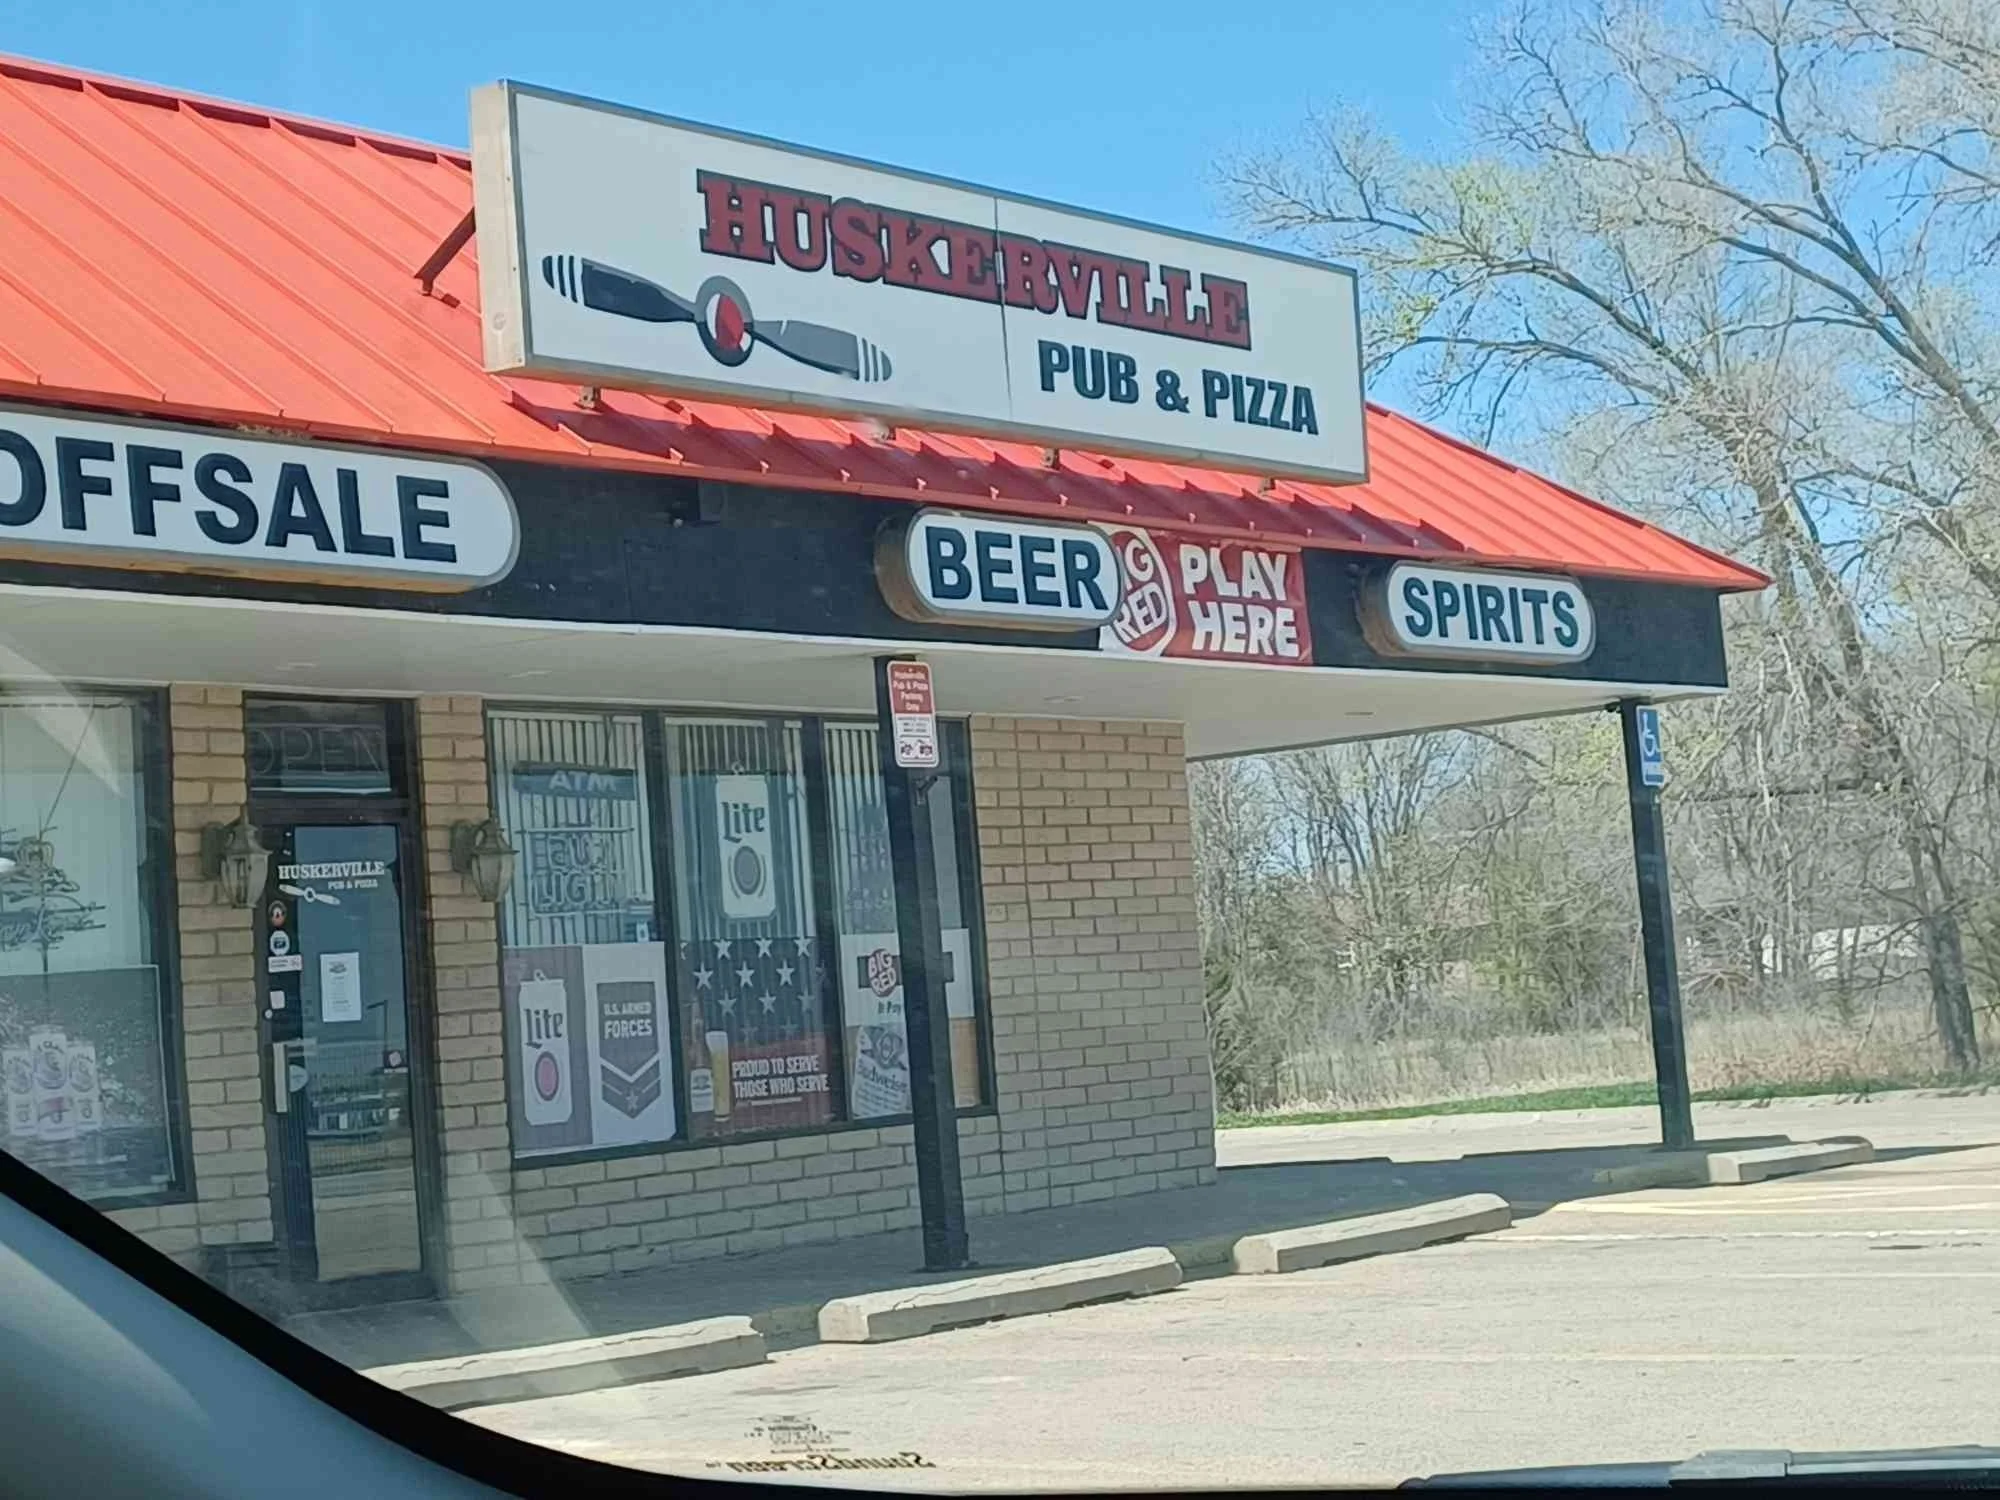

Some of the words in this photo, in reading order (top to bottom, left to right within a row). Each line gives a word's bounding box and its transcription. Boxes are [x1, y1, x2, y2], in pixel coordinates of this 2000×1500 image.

[697, 169, 1251, 350] HUSKERVILLE
[1038, 340, 1139, 404] PUB
[1156, 370, 1190, 413] &
[1202, 369, 1319, 436] PIZZA
[925, 526, 1109, 610] BEER
[1179, 544, 1287, 600] PLAY
[1113, 582, 1167, 643] RED
[1188, 600, 1299, 657] HERE
[1403, 577, 1579, 647] SPIRITS
[550, 770, 617, 792] ATM
[720, 801, 765, 843] Lite
[278, 861, 385, 879] HUSKERVILLE
[868, 951, 892, 978] BIG
[871, 967, 897, 993] RED
[523, 1008, 563, 1049] Lite
[622, 1001, 652, 1015] ARMED
[604, 1019, 653, 1039] FORCES
[732, 1058, 769, 1078] PROUD
[770, 1057, 785, 1074] TO
[787, 1054, 820, 1074] SERVE
[733, 1078, 768, 1098] THOSE
[769, 1076, 795, 1096] WHO
[796, 1074, 830, 1093] SERVE
